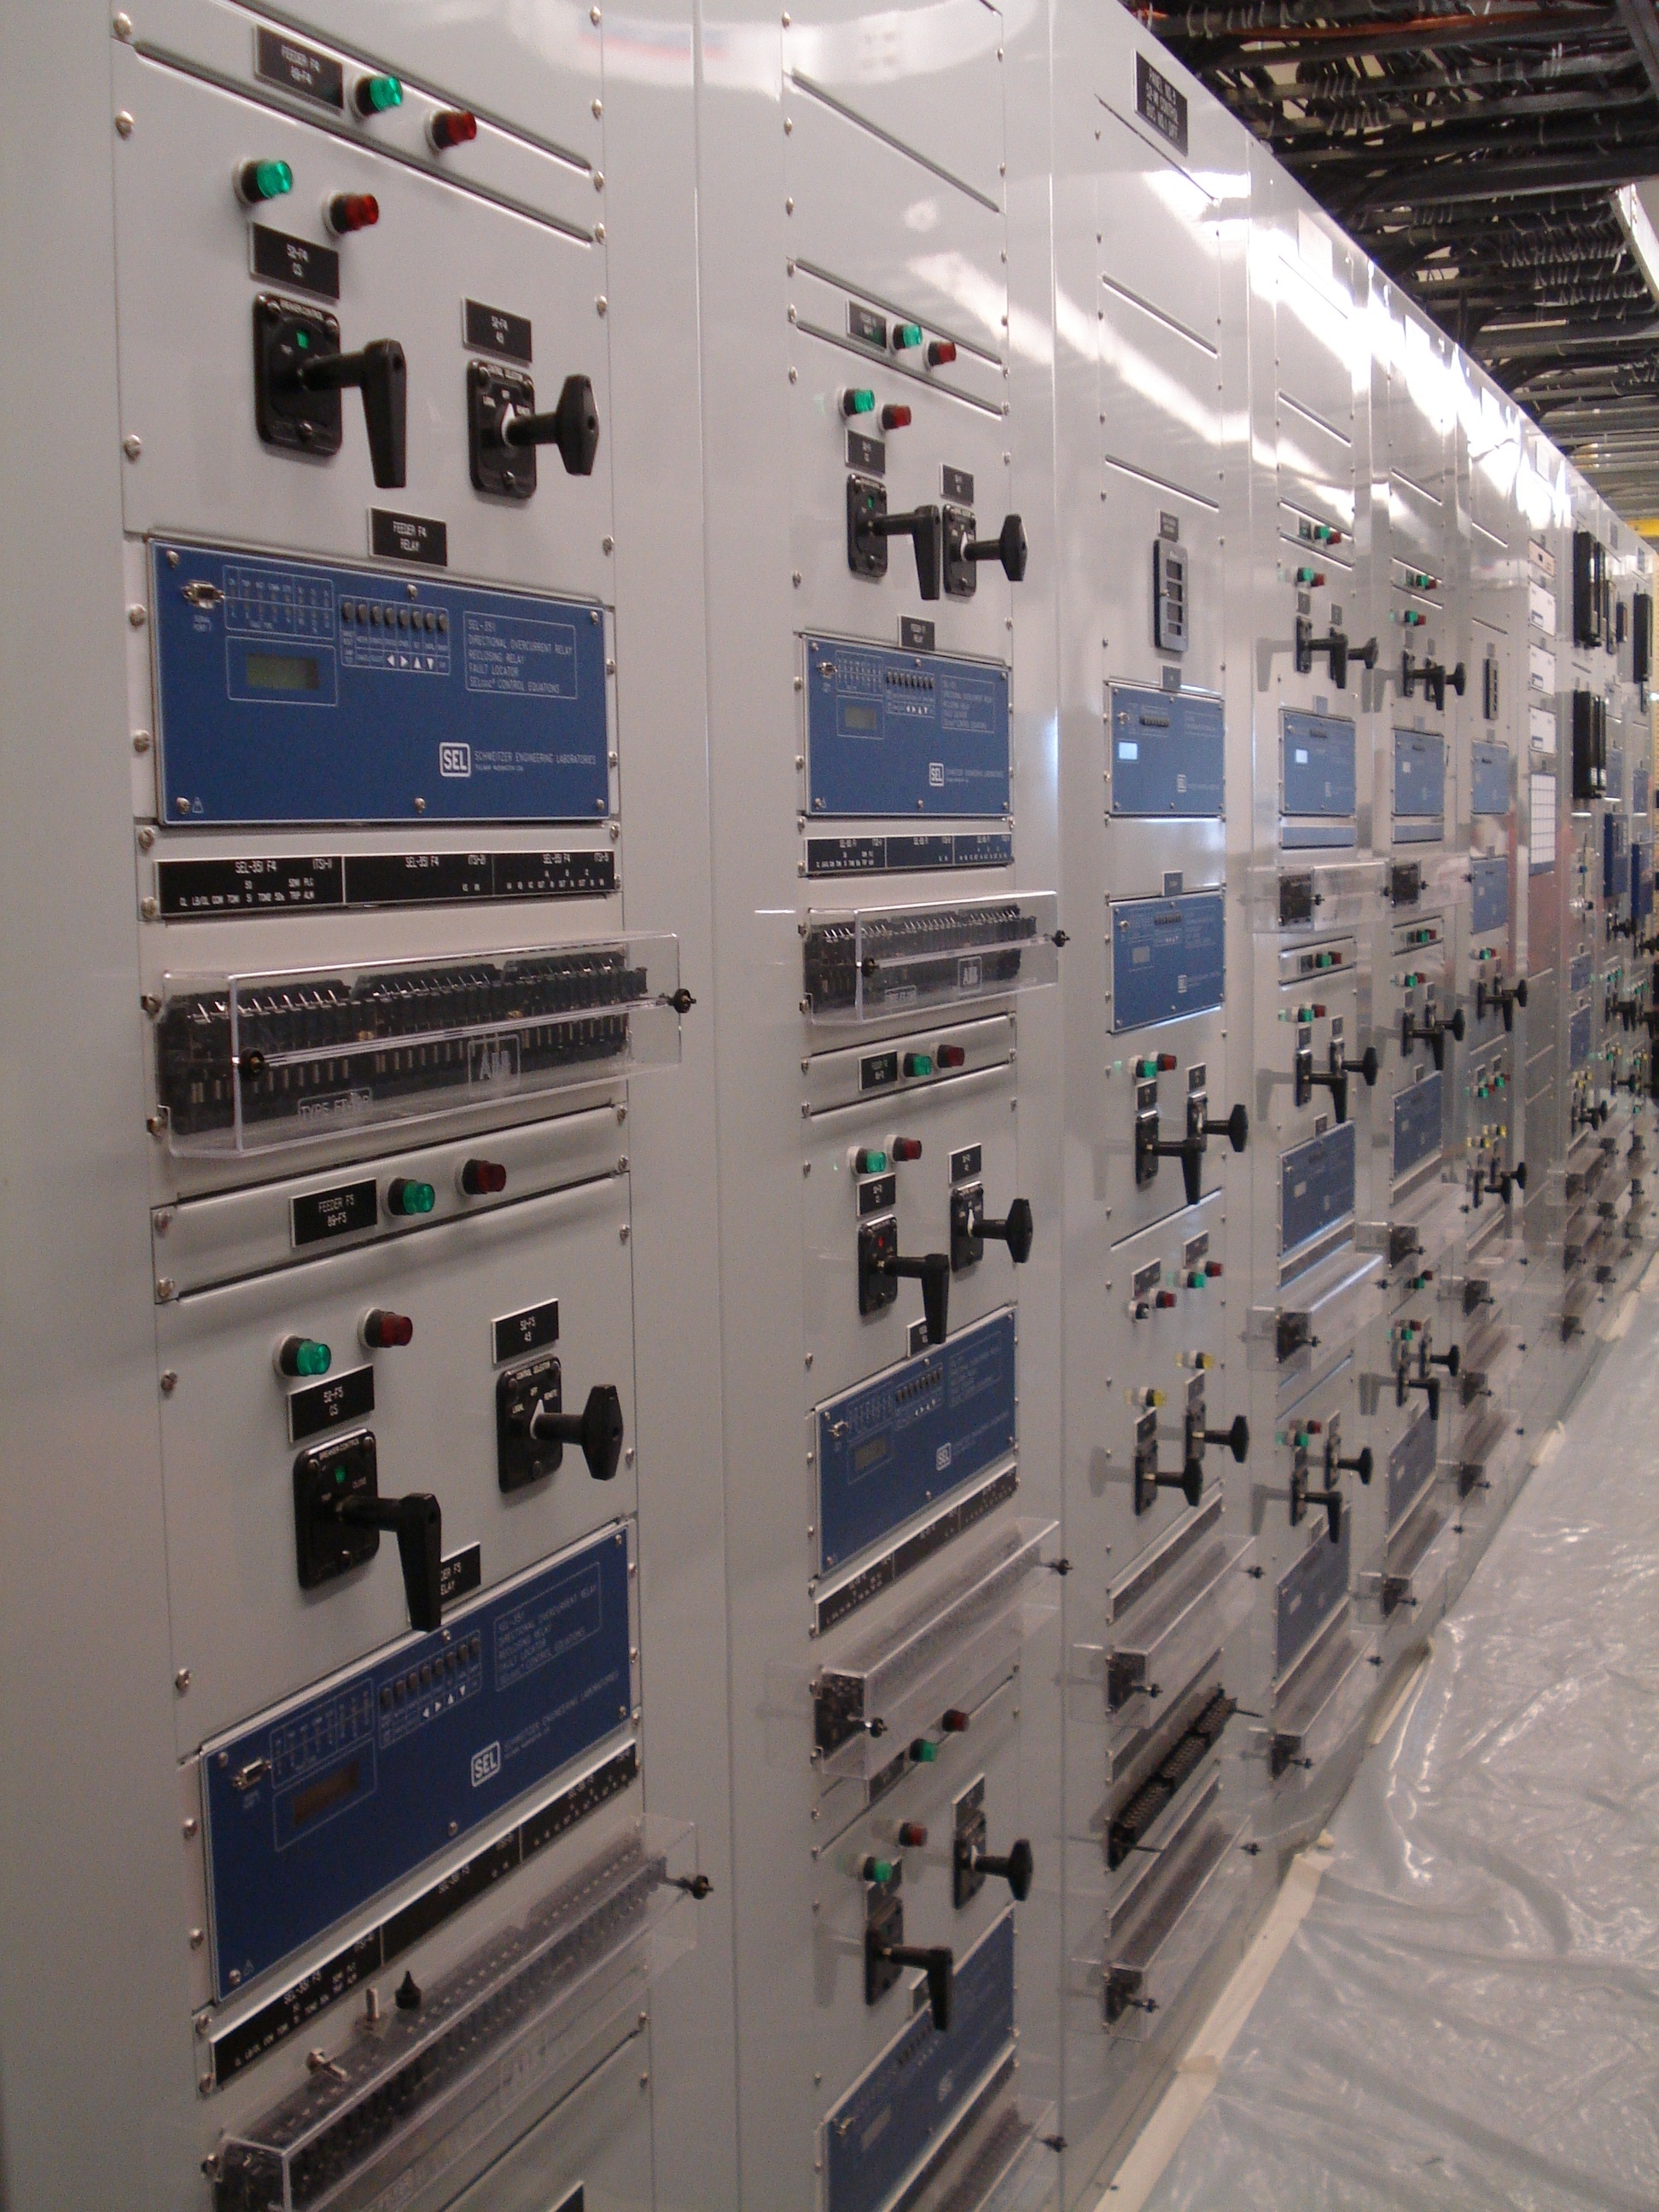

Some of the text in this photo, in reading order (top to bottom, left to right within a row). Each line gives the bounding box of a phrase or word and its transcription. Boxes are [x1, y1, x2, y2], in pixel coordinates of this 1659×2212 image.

[393, 520, 428, 538] FEEDER F4
[400, 538, 420, 552] RELAY
[443, 749, 467, 771] SEL
[266, 861, 277, 872] F4
[318, 1194, 355, 1213] FEEDER F5
[520, 1316, 536, 1331] 52-F5
[323, 1386, 343, 1404] 52-F5
[454, 1562, 462, 1574] F5
[474, 1751, 498, 1779] SEL
